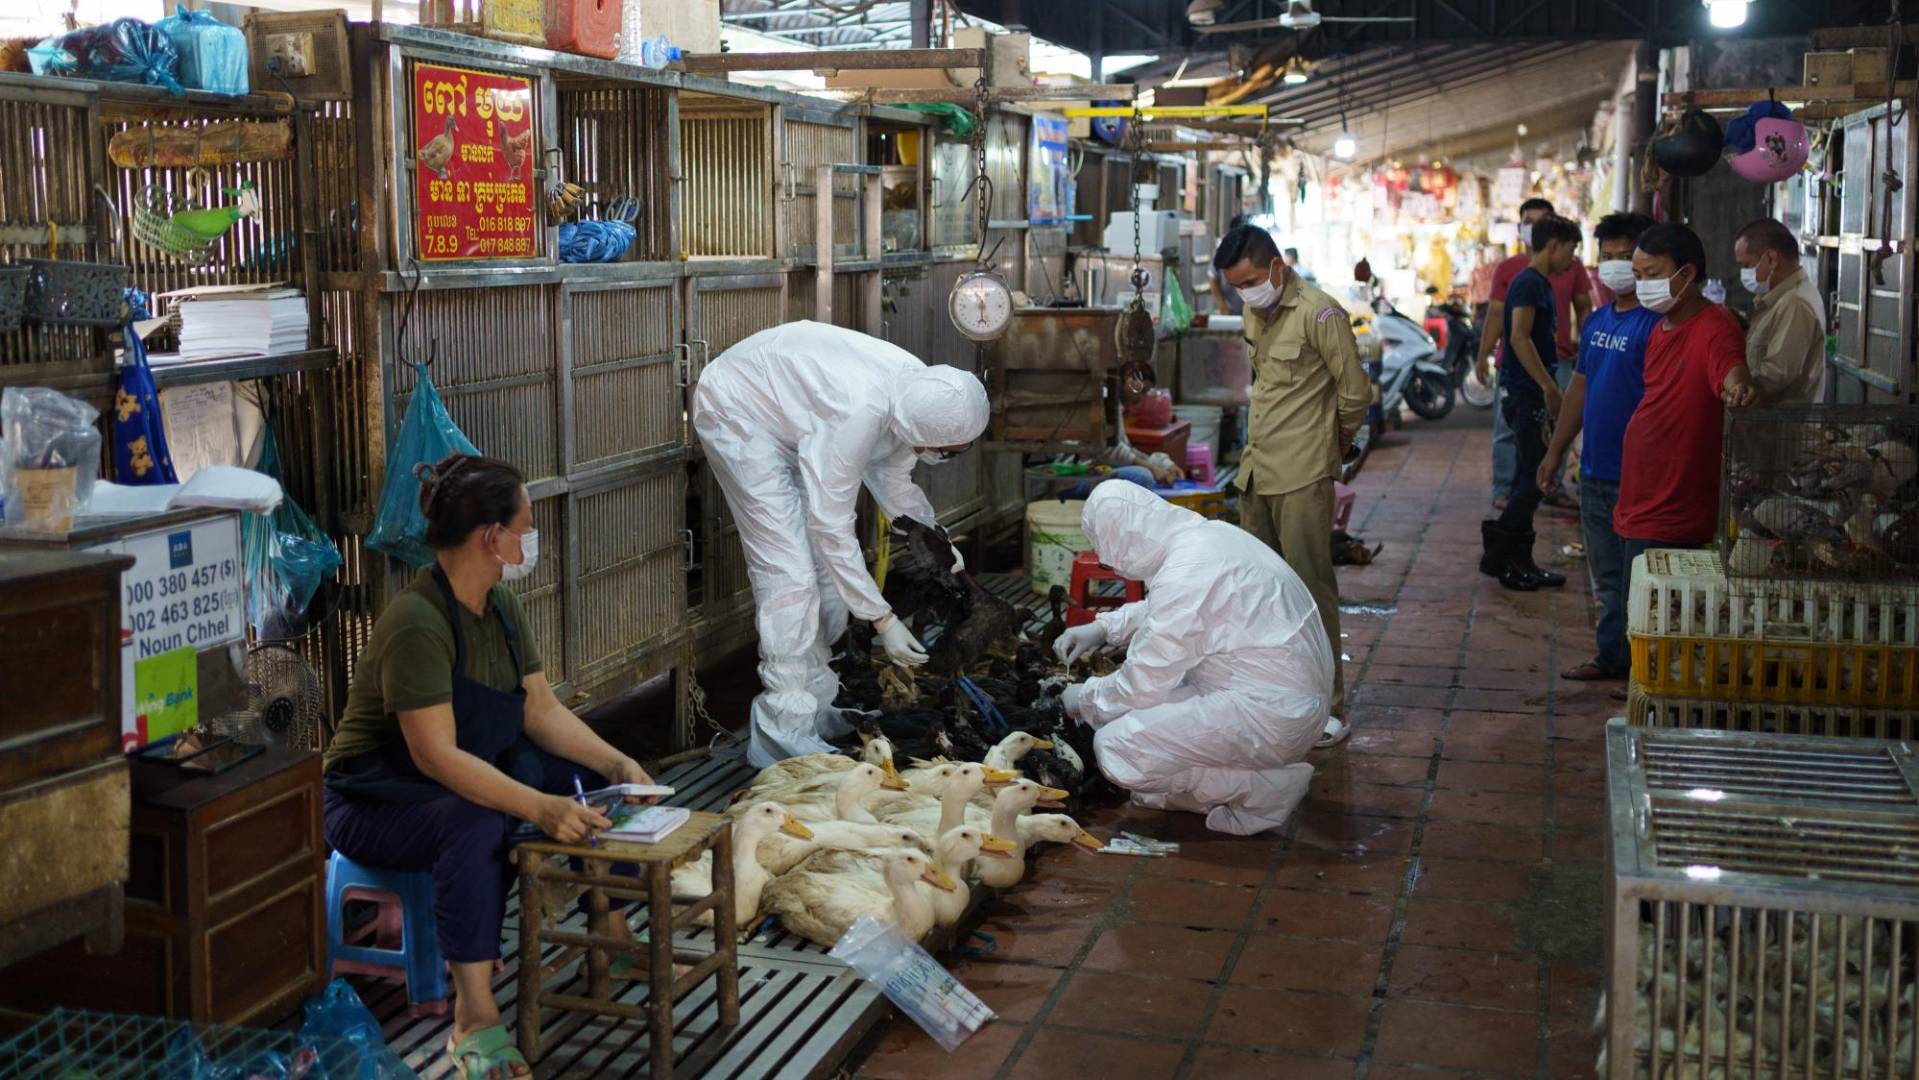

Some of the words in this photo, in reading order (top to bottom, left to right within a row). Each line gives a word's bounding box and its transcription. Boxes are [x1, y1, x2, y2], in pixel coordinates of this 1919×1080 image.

[479, 216, 496, 232] 016
[497, 216, 513, 232] 818
[425, 235, 458, 253] 7.8.9
[480, 237, 496, 253] 017
[497, 237, 514, 253] 848
[159, 572, 187, 597] 380
[191, 564, 217, 588] 457
[220, 558, 236, 580] ($)
[161, 600, 188, 625] 463
[193, 592, 219, 617] 825
[139, 633, 182, 658] Noun
[186, 614, 229, 644] Chhel
